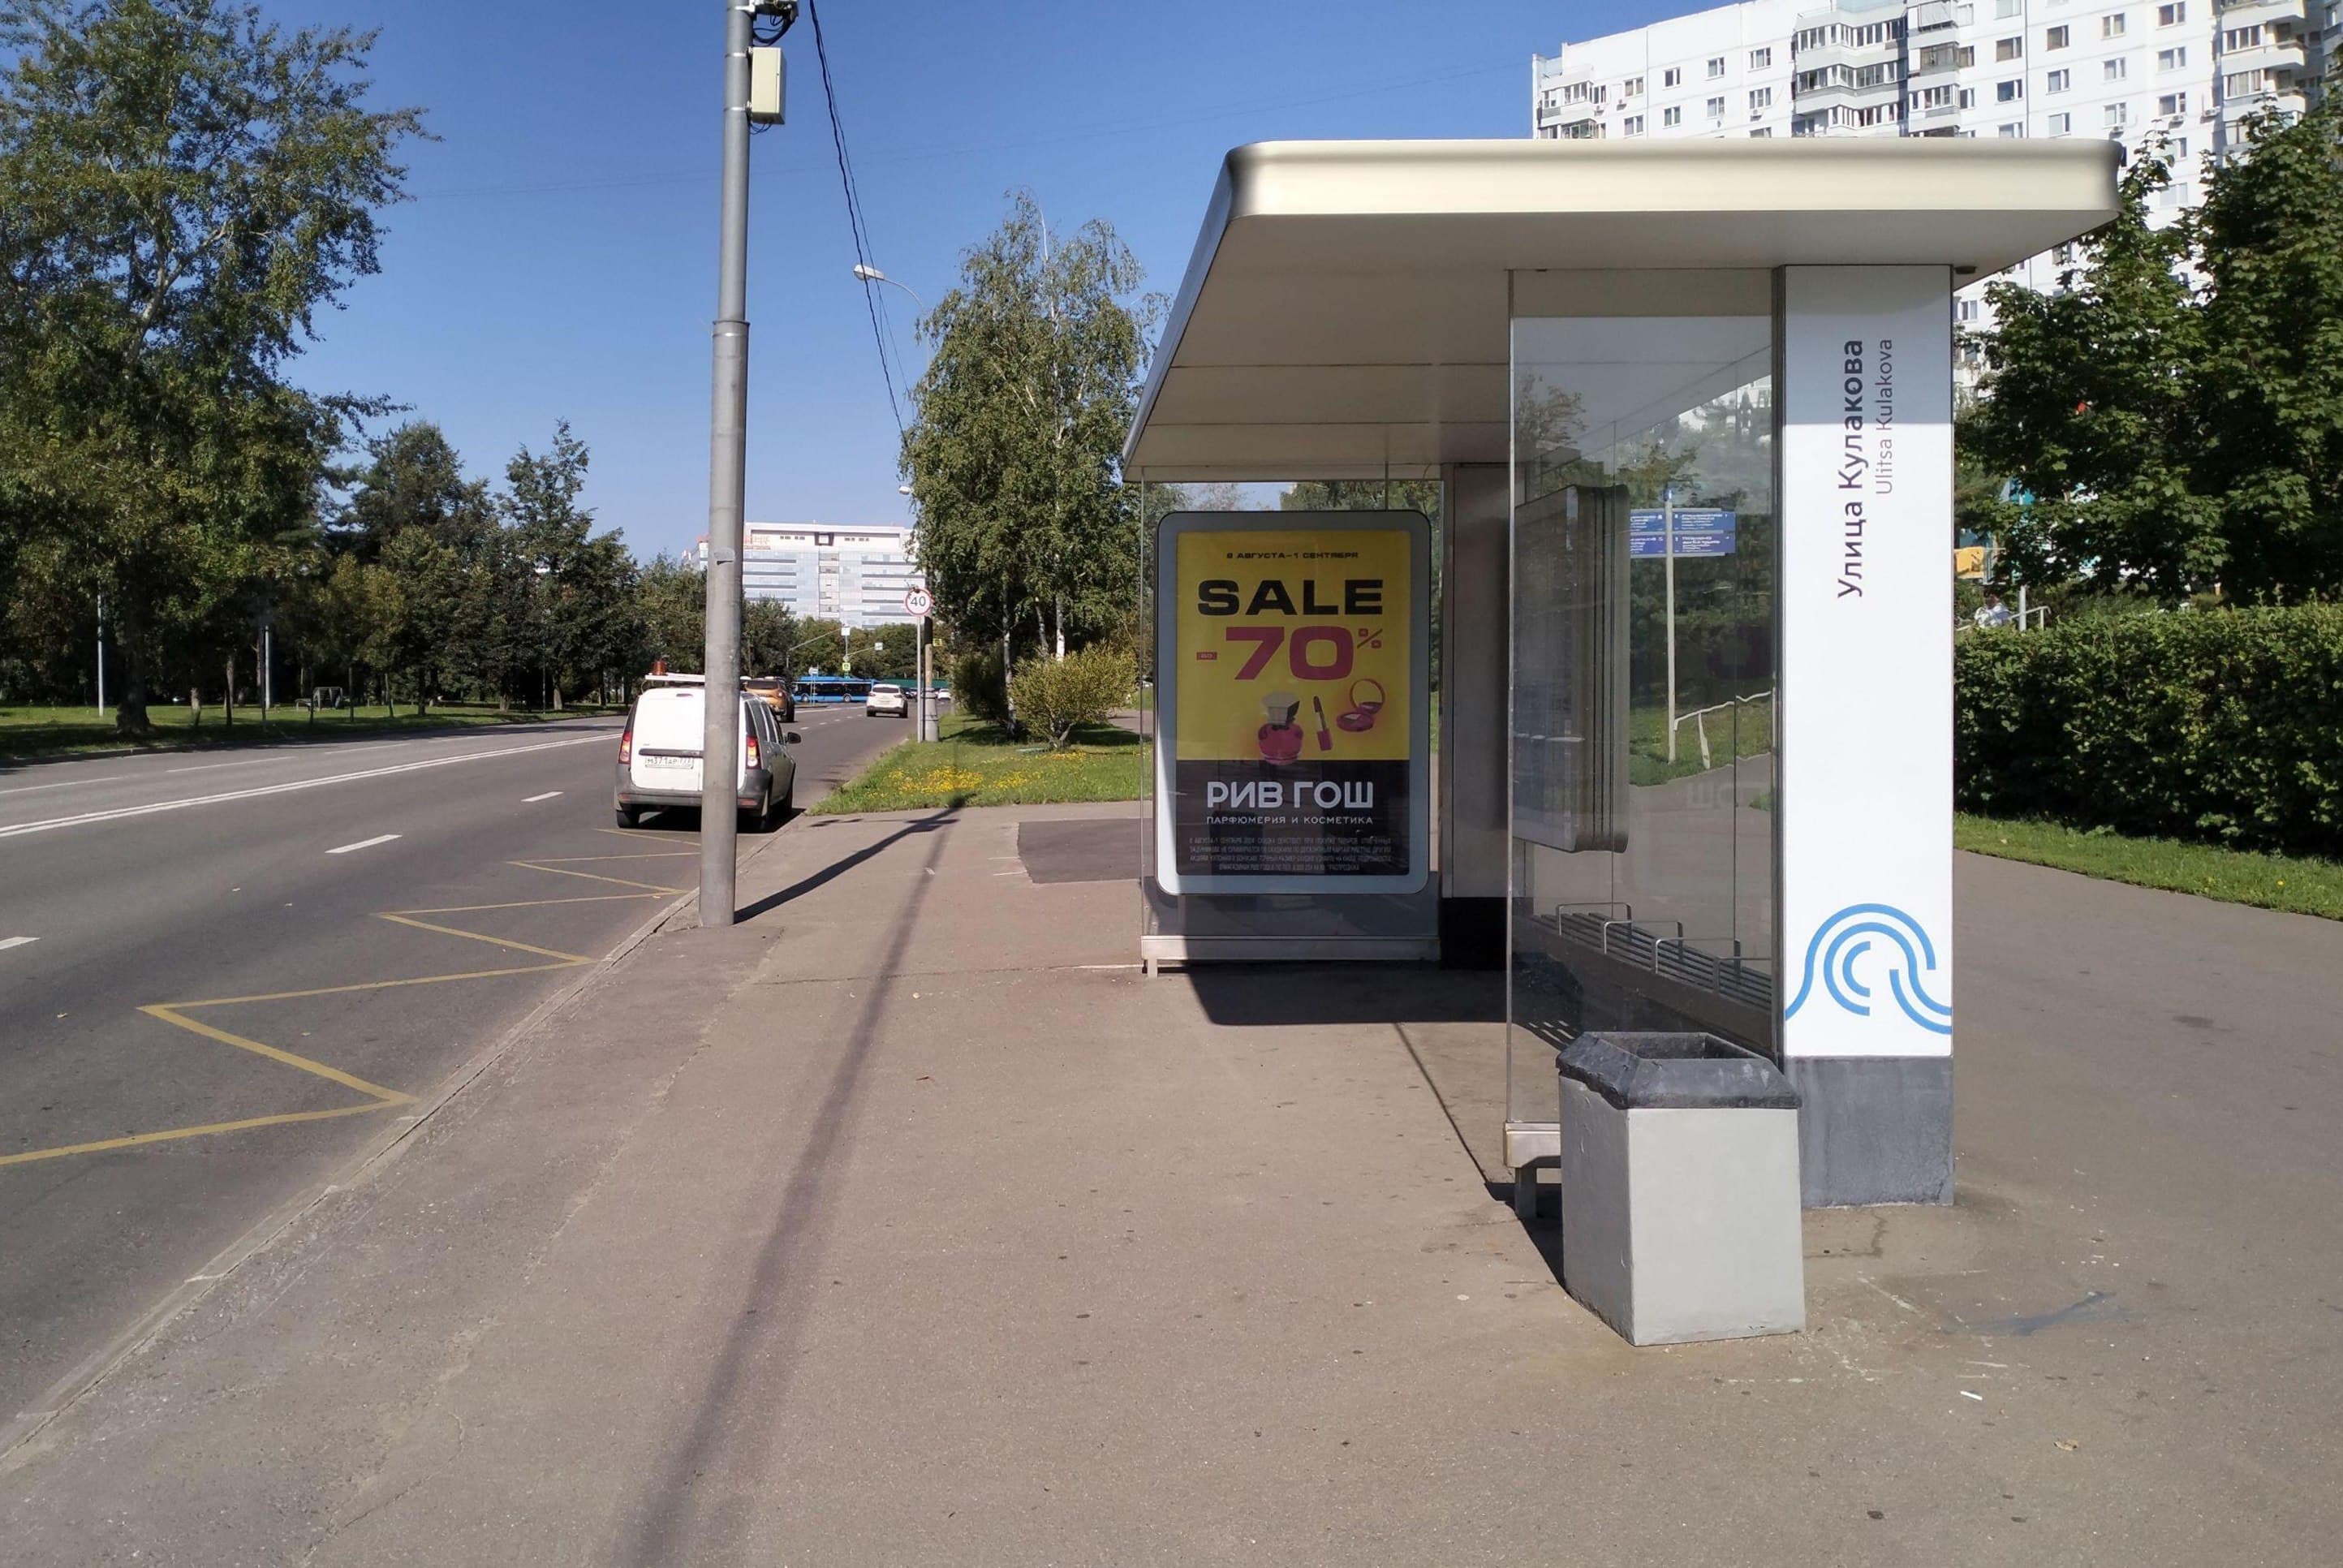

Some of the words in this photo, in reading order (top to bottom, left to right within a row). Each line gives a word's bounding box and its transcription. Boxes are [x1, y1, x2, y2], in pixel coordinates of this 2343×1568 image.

[1875, 339, 1893, 430] Kulakova
[1838, 340, 1868, 489] Кулакова
[1875, 439, 1893, 494] Ulitsa
[1837, 501, 1867, 597] Улица
[910, 596, 926, 607] 40
[1198, 579, 1383, 616] SALE
[1207, 782, 1283, 808] РИВ
[1294, 782, 1374, 808] ГОШ
[1206, 816, 1286, 825] ПАРФЮМЕРИЯ
[1291, 816, 1299, 825] И
[1303, 816, 1374, 825] КОСМЕТИКА
